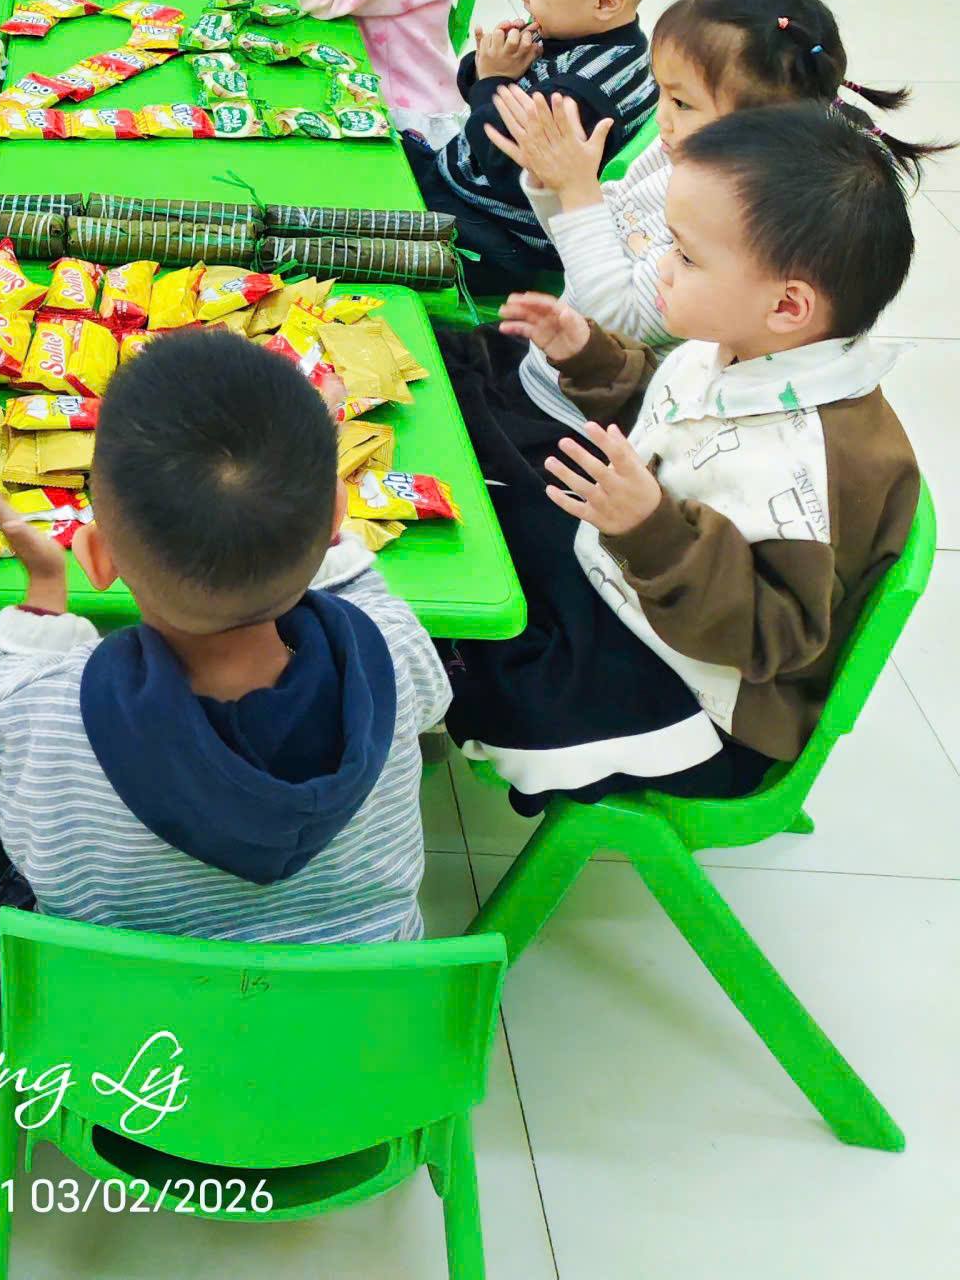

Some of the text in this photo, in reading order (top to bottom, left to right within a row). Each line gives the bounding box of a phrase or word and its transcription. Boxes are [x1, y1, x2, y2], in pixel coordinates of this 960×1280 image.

[61, 271, 85, 303] Solite
[40, 336, 65, 377] Solite
[792, 466, 831, 540] ASELINE
